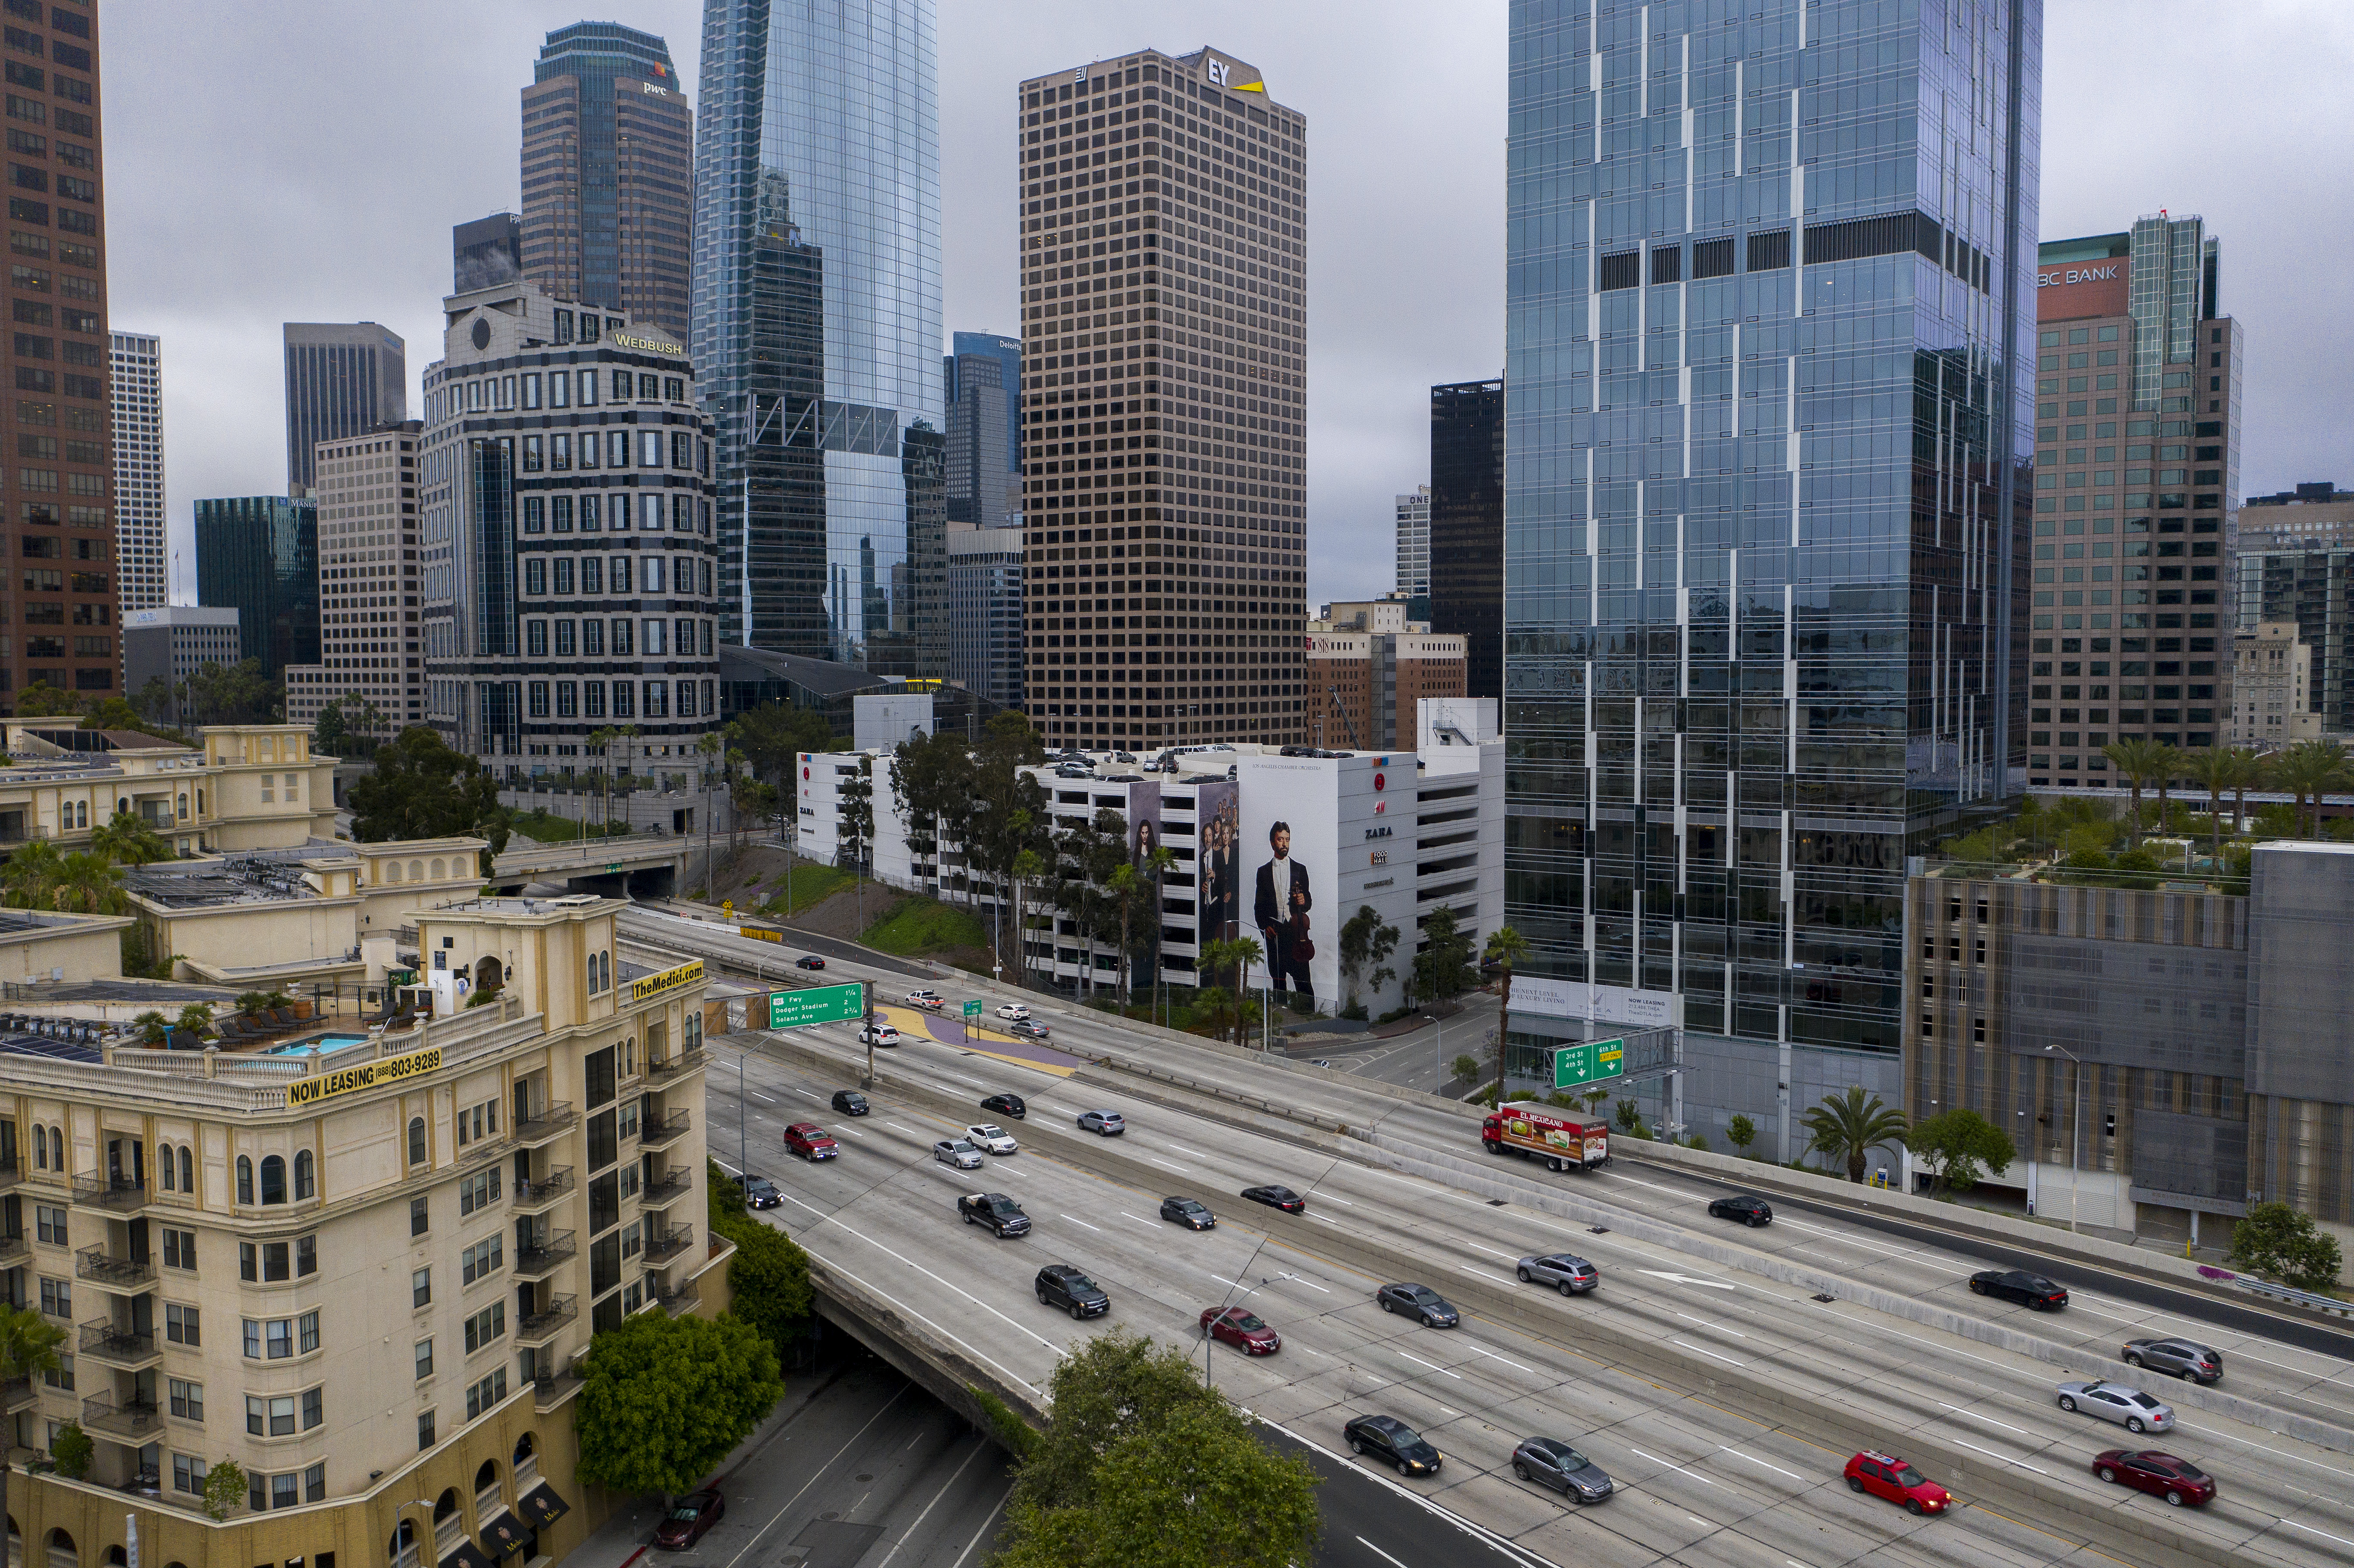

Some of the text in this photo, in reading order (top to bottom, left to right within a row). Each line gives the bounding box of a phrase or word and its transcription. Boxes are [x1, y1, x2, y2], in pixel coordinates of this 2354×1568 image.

[1208, 57, 1230, 86] EY
[643, 82, 667, 96] pwc
[2066, 265, 2117, 284] BANK
[615, 333, 681, 355] WEDBUSH
[1000, 340, 1021, 351] Deloitte
[1318, 637, 1329, 653] 818
[800, 807, 815, 816] ZARA
[1365, 826, 1393, 839] ZARA
[635, 966, 702, 998] TheMedici.com
[801, 1002, 828, 1010] Stadium
[1578, 1005, 1611, 1013] THEA
[291, 1080, 321, 1104] NOW
[324, 1066, 374, 1095] LEASING
[1529, 1114, 1563, 1128] MEXICANO
[544, 1509, 560, 1521] Medici
[506, 1538, 523, 1552] Medici
